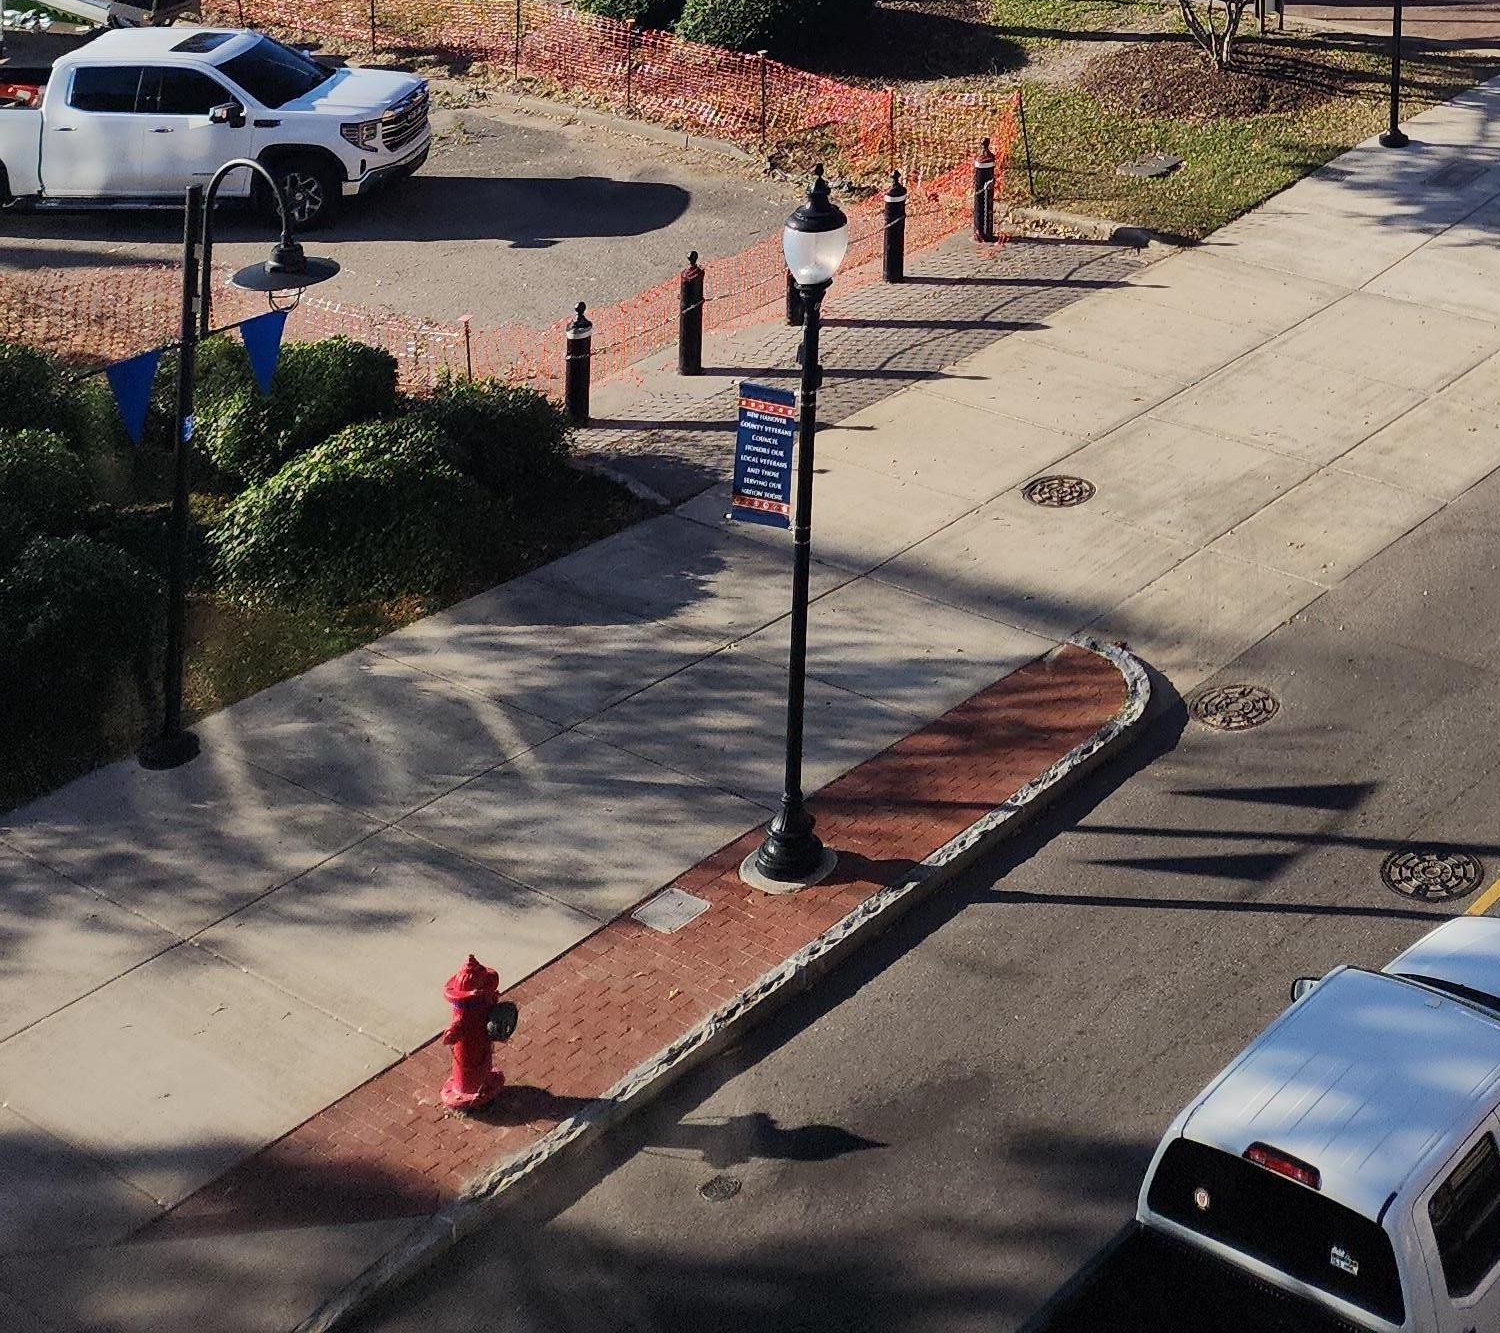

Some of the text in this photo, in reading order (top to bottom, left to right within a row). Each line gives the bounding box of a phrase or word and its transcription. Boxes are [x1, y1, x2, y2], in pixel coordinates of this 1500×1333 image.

[740, 420, 792, 437] COUNTY VETERANS
[751, 434, 779, 445] COUNCIL
[744, 444, 785, 457] HONORS OUR
[740, 454, 788, 469] LOCAL VETERANS
[746, 466, 761, 475] AND
[743, 476, 782, 490] SERVING OUR
